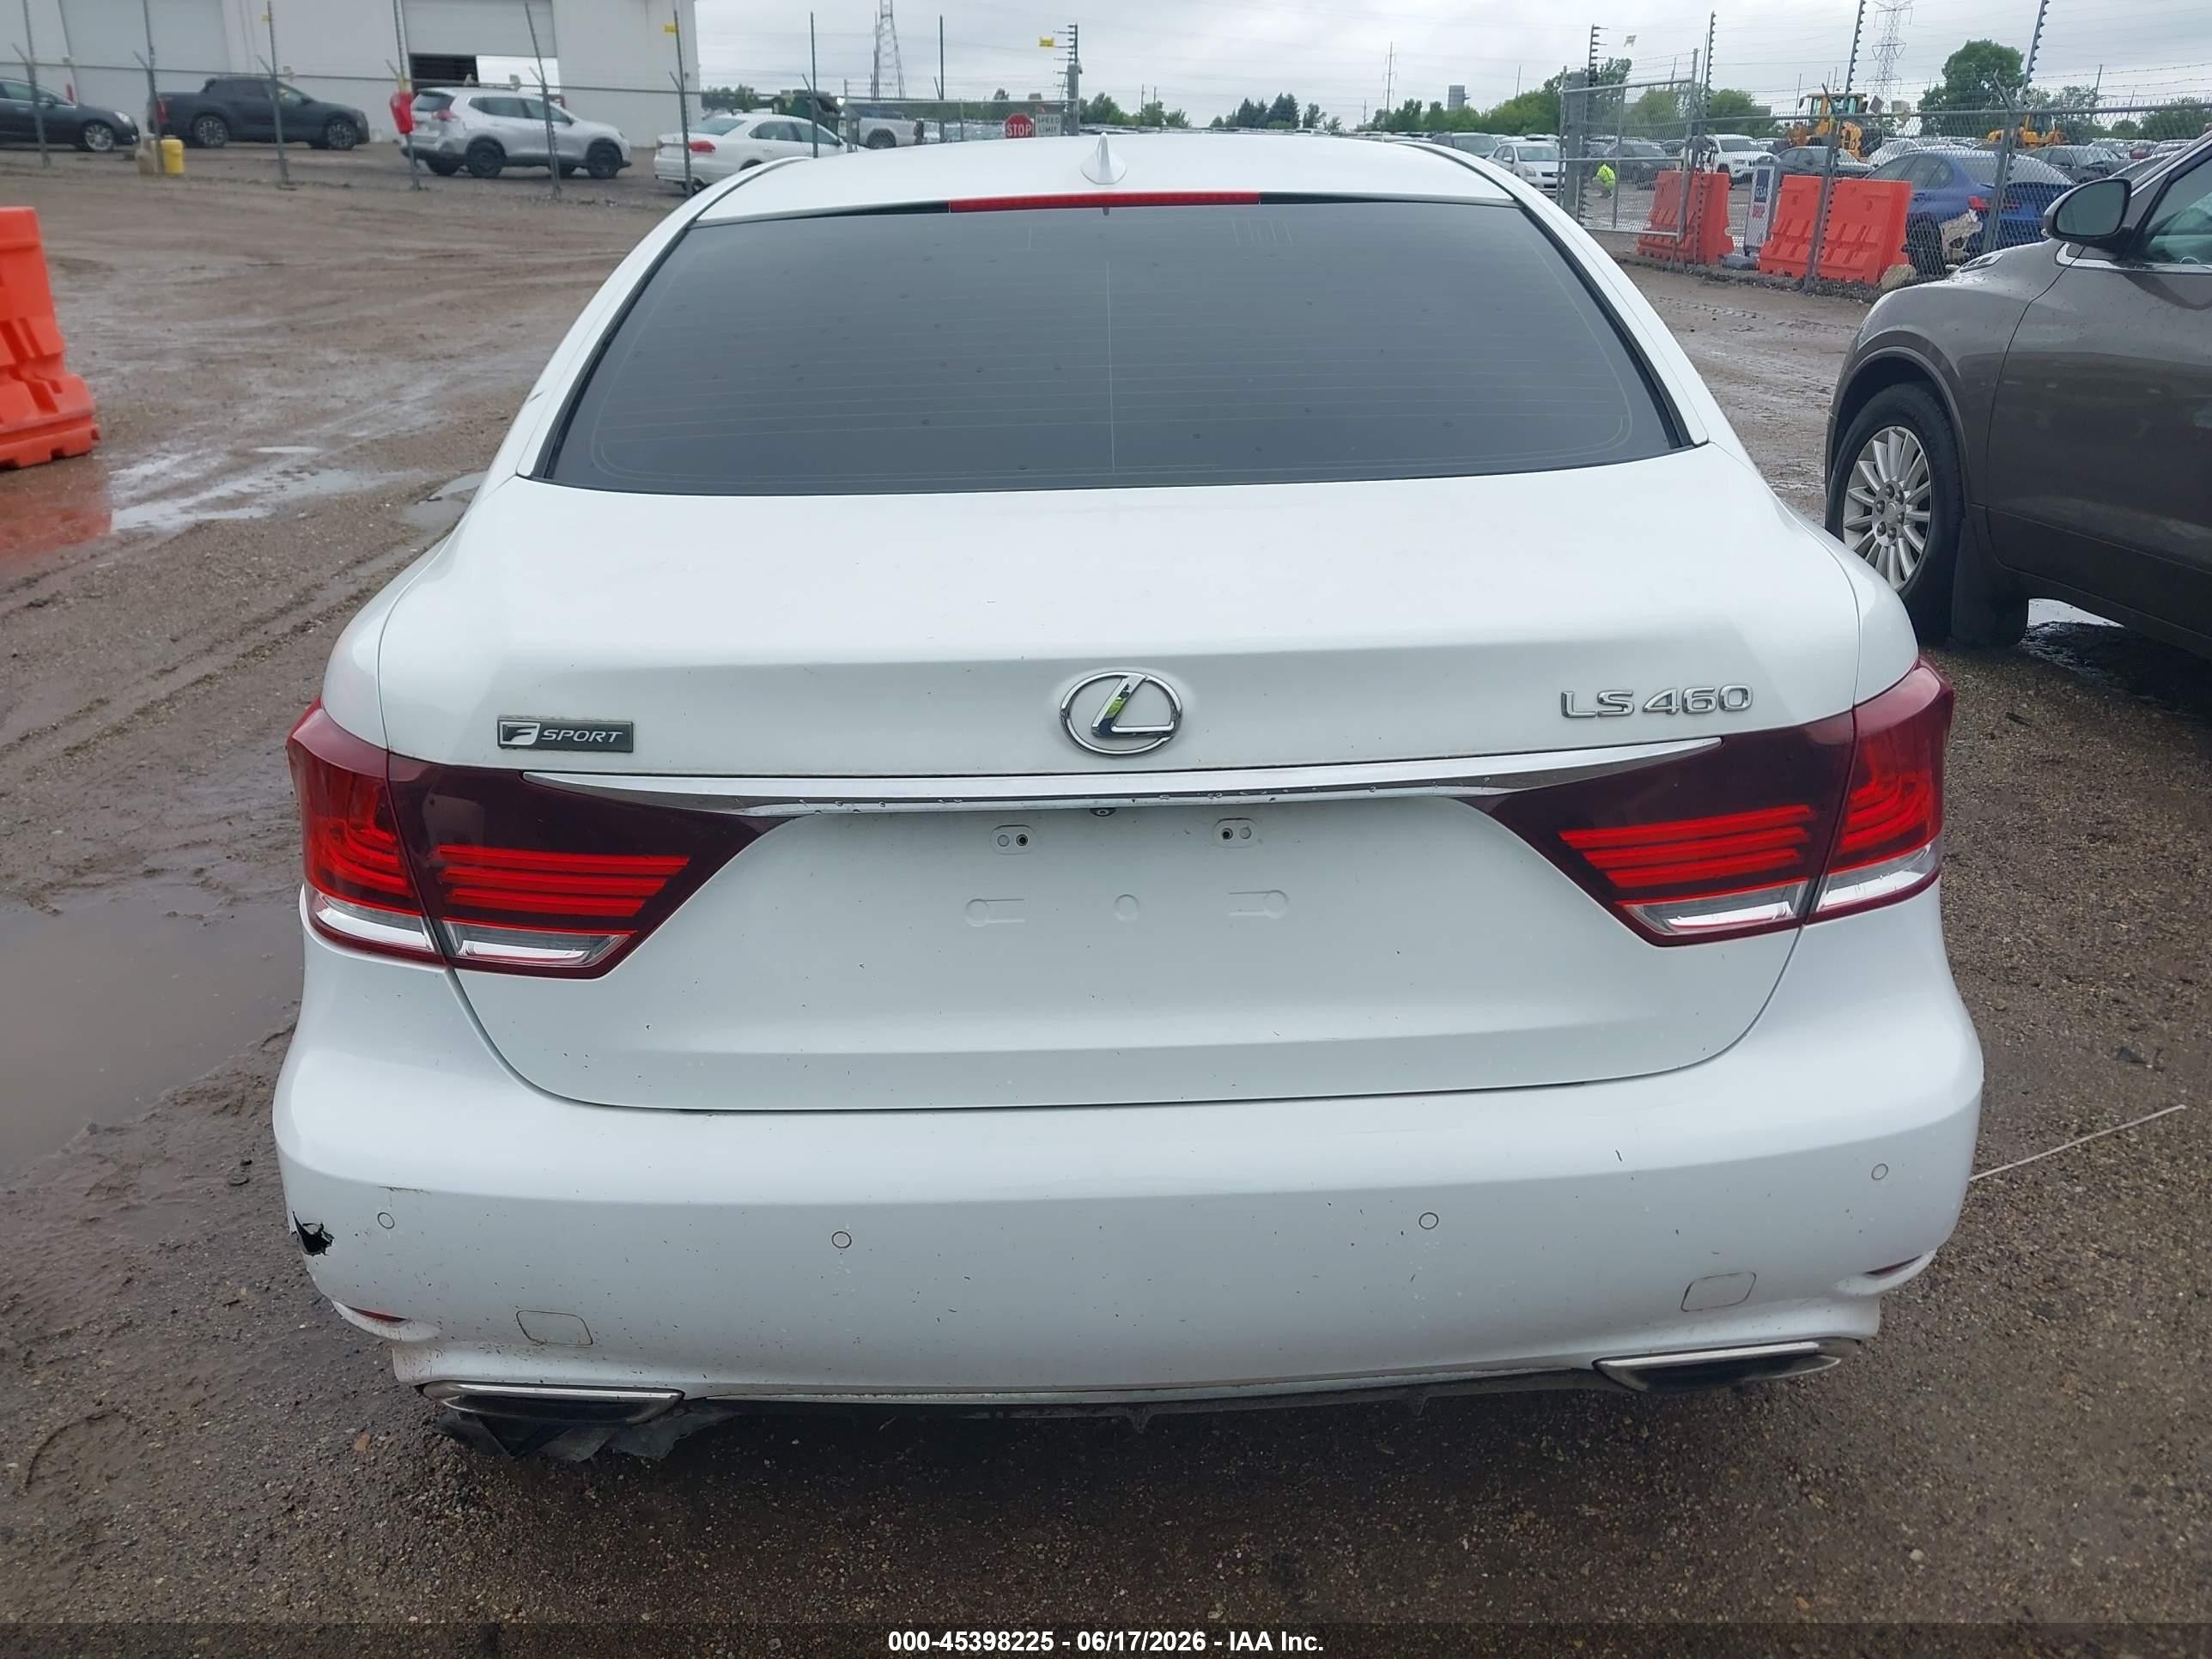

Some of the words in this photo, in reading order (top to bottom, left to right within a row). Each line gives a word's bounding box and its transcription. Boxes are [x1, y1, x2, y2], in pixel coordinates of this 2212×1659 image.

[1006, 124, 1032, 137] STOP
[1561, 689, 1635, 719] LS
[1642, 684, 1753, 715] 460
[541, 728, 623, 744] SPORT
